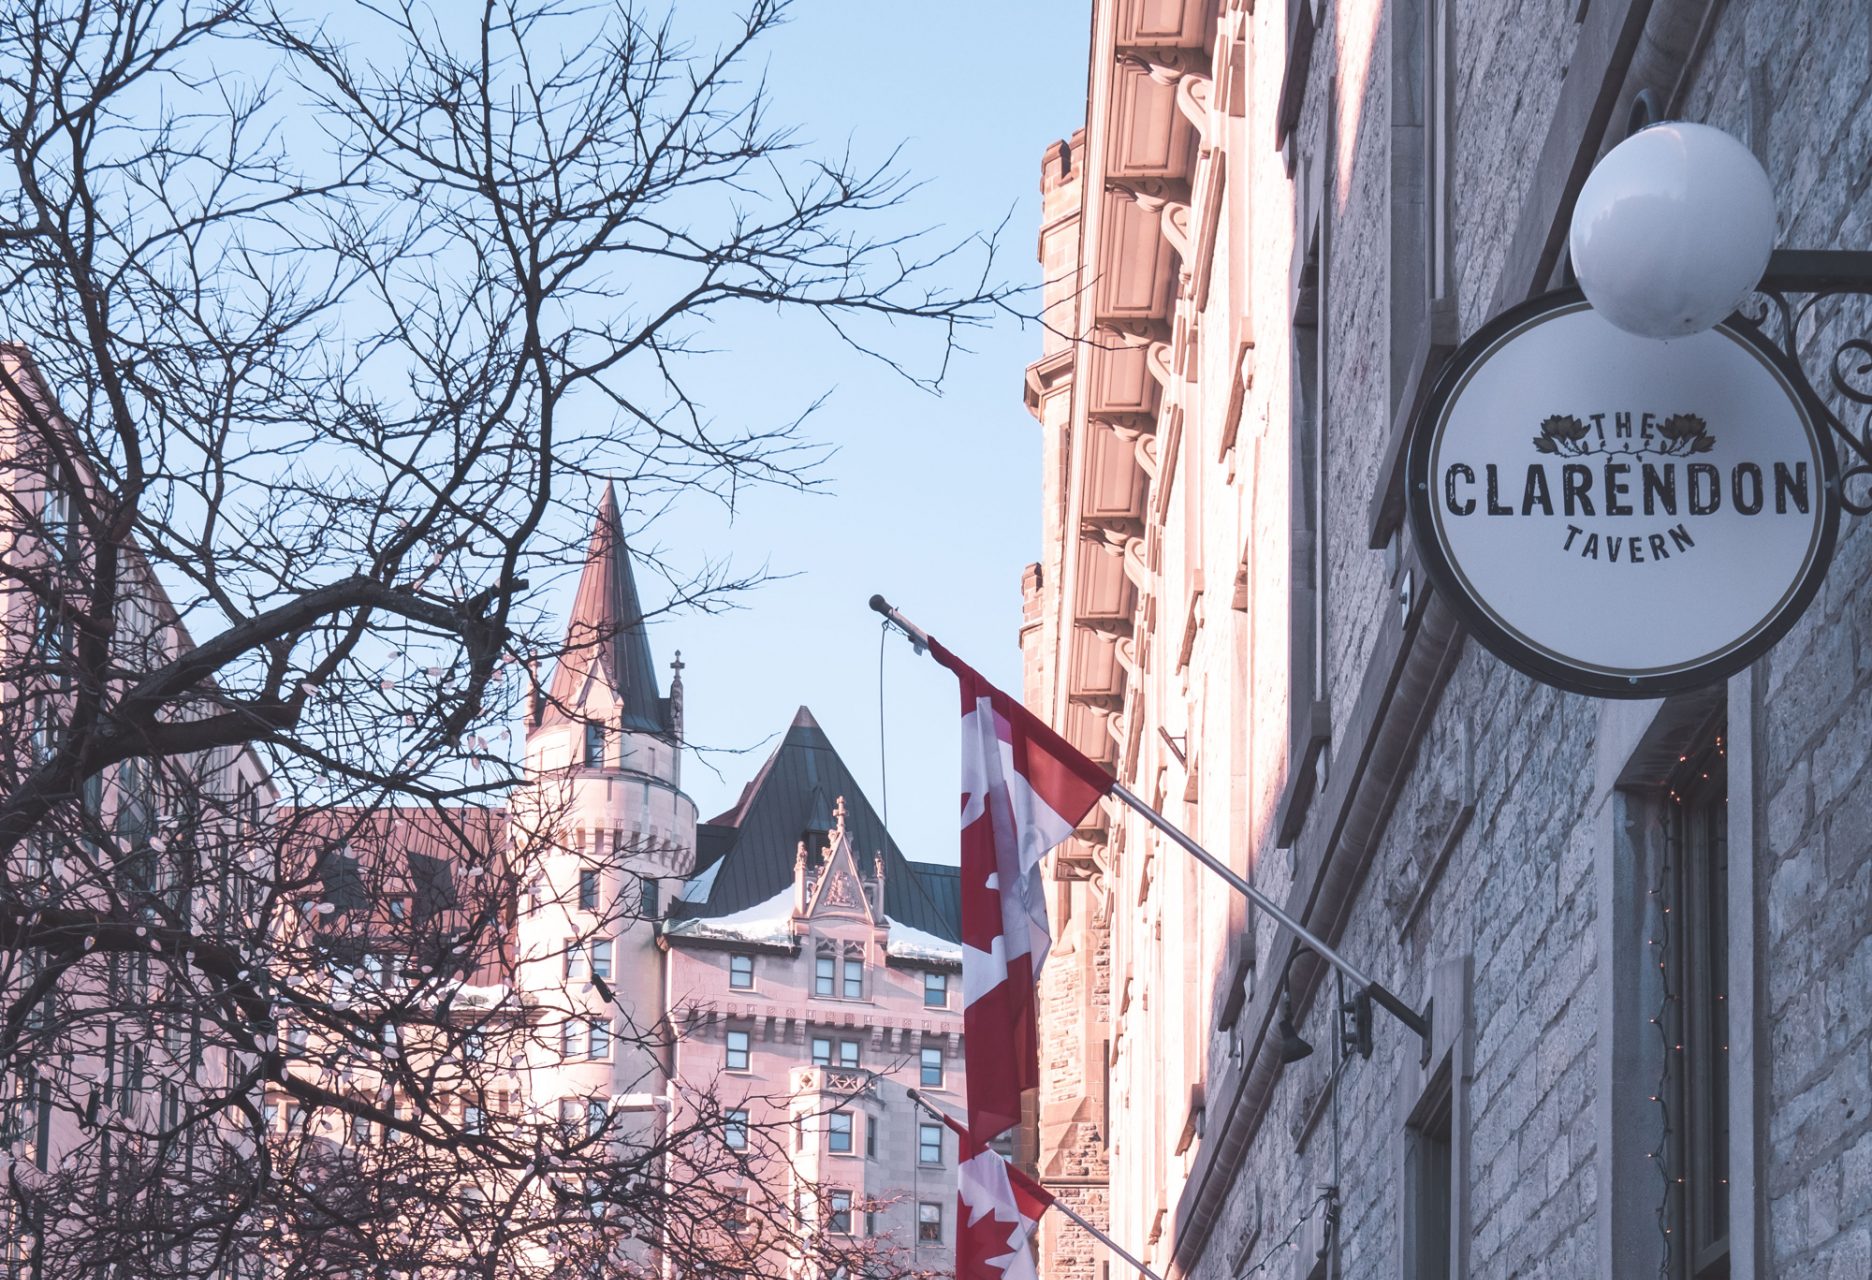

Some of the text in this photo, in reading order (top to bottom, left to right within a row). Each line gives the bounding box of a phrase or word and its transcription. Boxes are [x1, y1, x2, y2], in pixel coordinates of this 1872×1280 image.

[1590, 412, 1656, 440] THE
[1445, 462, 1810, 516] CLARENDON
[1563, 523, 1695, 563] TAVERN
